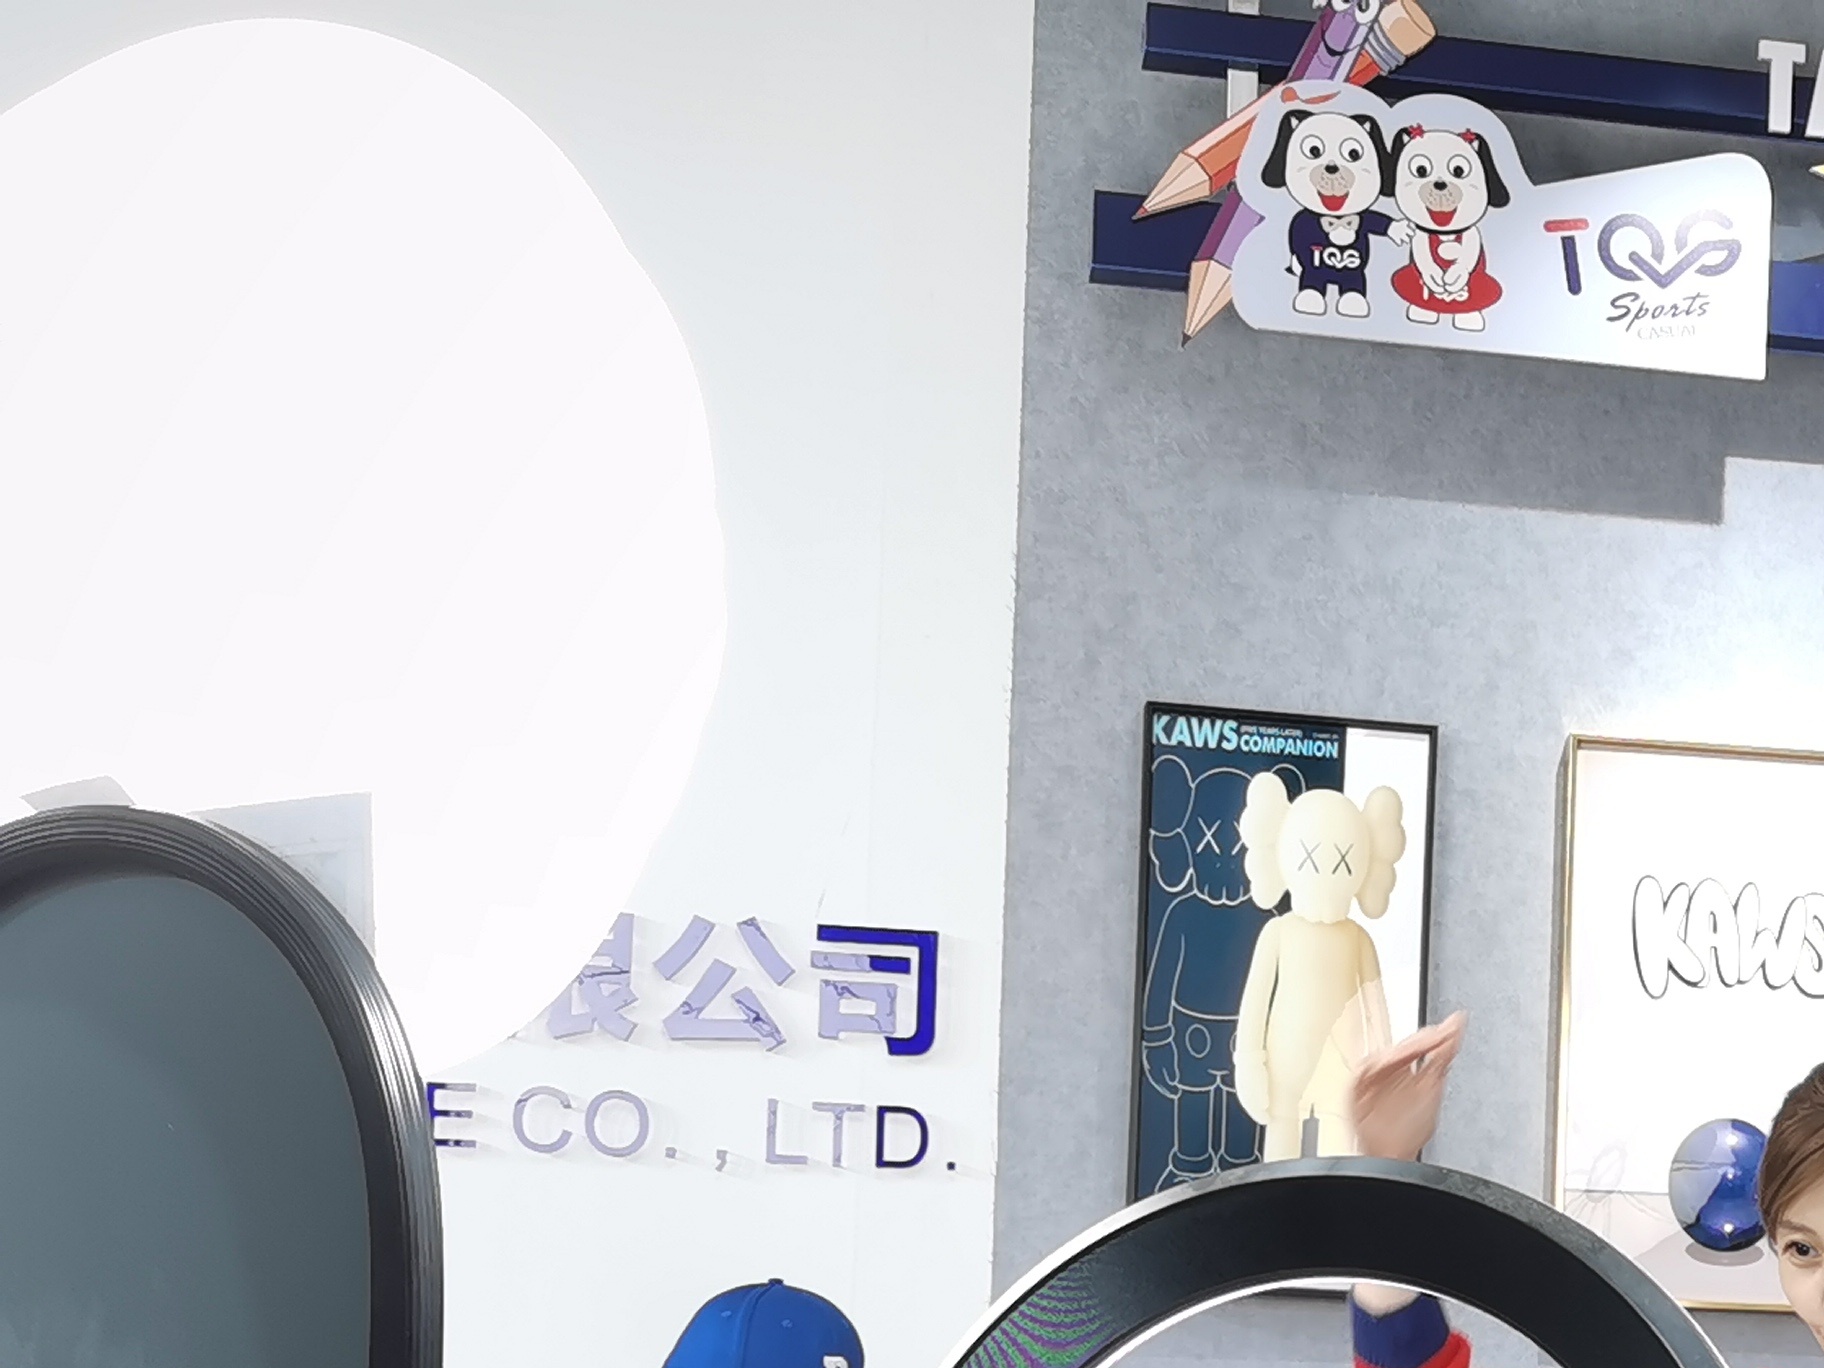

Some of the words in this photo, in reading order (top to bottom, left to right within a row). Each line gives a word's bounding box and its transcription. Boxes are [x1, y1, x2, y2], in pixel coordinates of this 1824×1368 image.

[1606, 291, 1710, 332] Sports
[1152, 712, 1239, 751] KAWS
[1240, 734, 1339, 759] COMPANION
